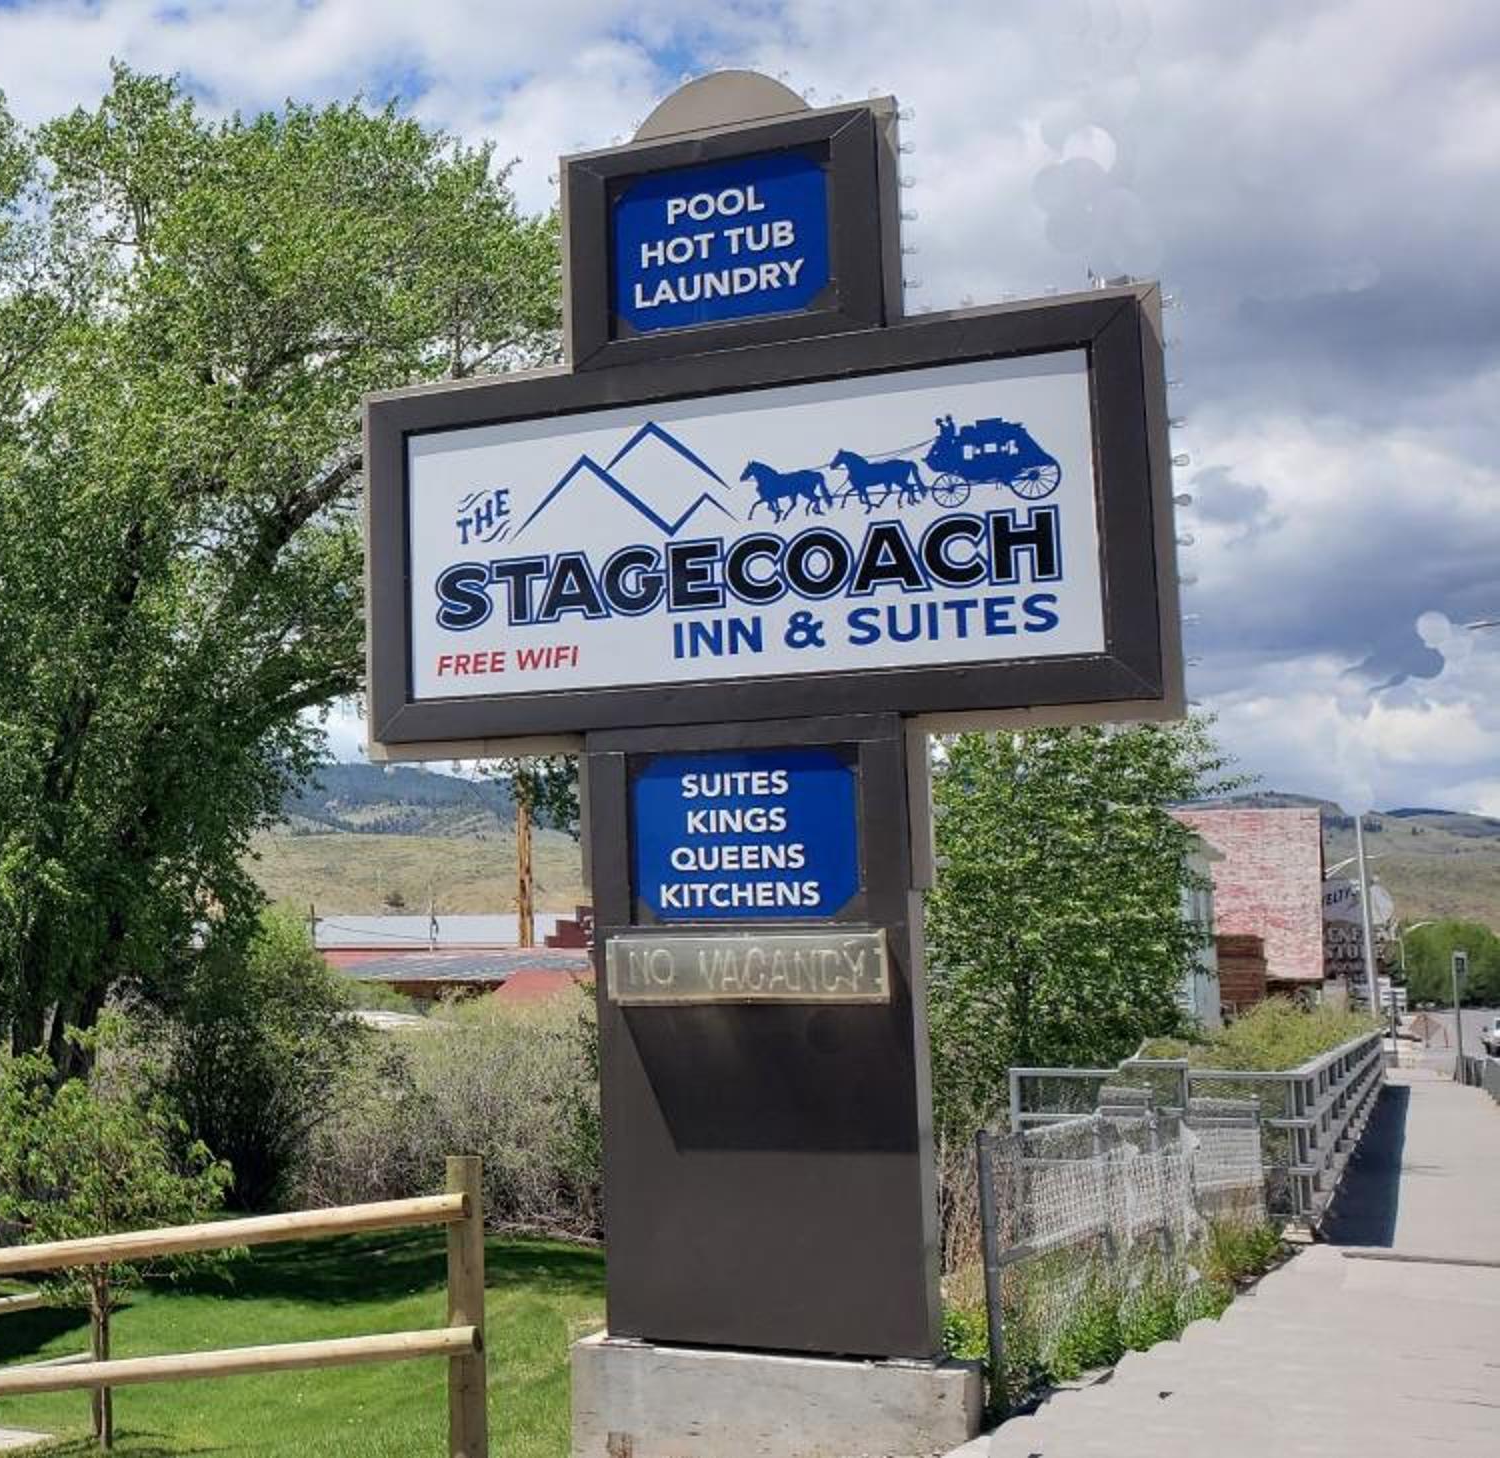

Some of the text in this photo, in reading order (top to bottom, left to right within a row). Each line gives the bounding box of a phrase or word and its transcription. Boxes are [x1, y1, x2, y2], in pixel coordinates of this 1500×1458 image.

[667, 185, 765, 225] POOL
[640, 220, 795, 269] HOT TUB
[634, 257, 804, 309] LAUNDRY
[456, 488, 511, 544] THE
[435, 504, 1062, 631] STAGECOACH
[673, 593, 1060, 659] INN & SUITES
[437, 645, 579, 677] FREE WIFI
[681, 769, 789, 799] SUITES
[687, 807, 787, 834] KINGS
[670, 843, 806, 872] QUEENS
[660, 881, 821, 908] KITCHENS
[628, 941, 865, 992] NO VACANCY
